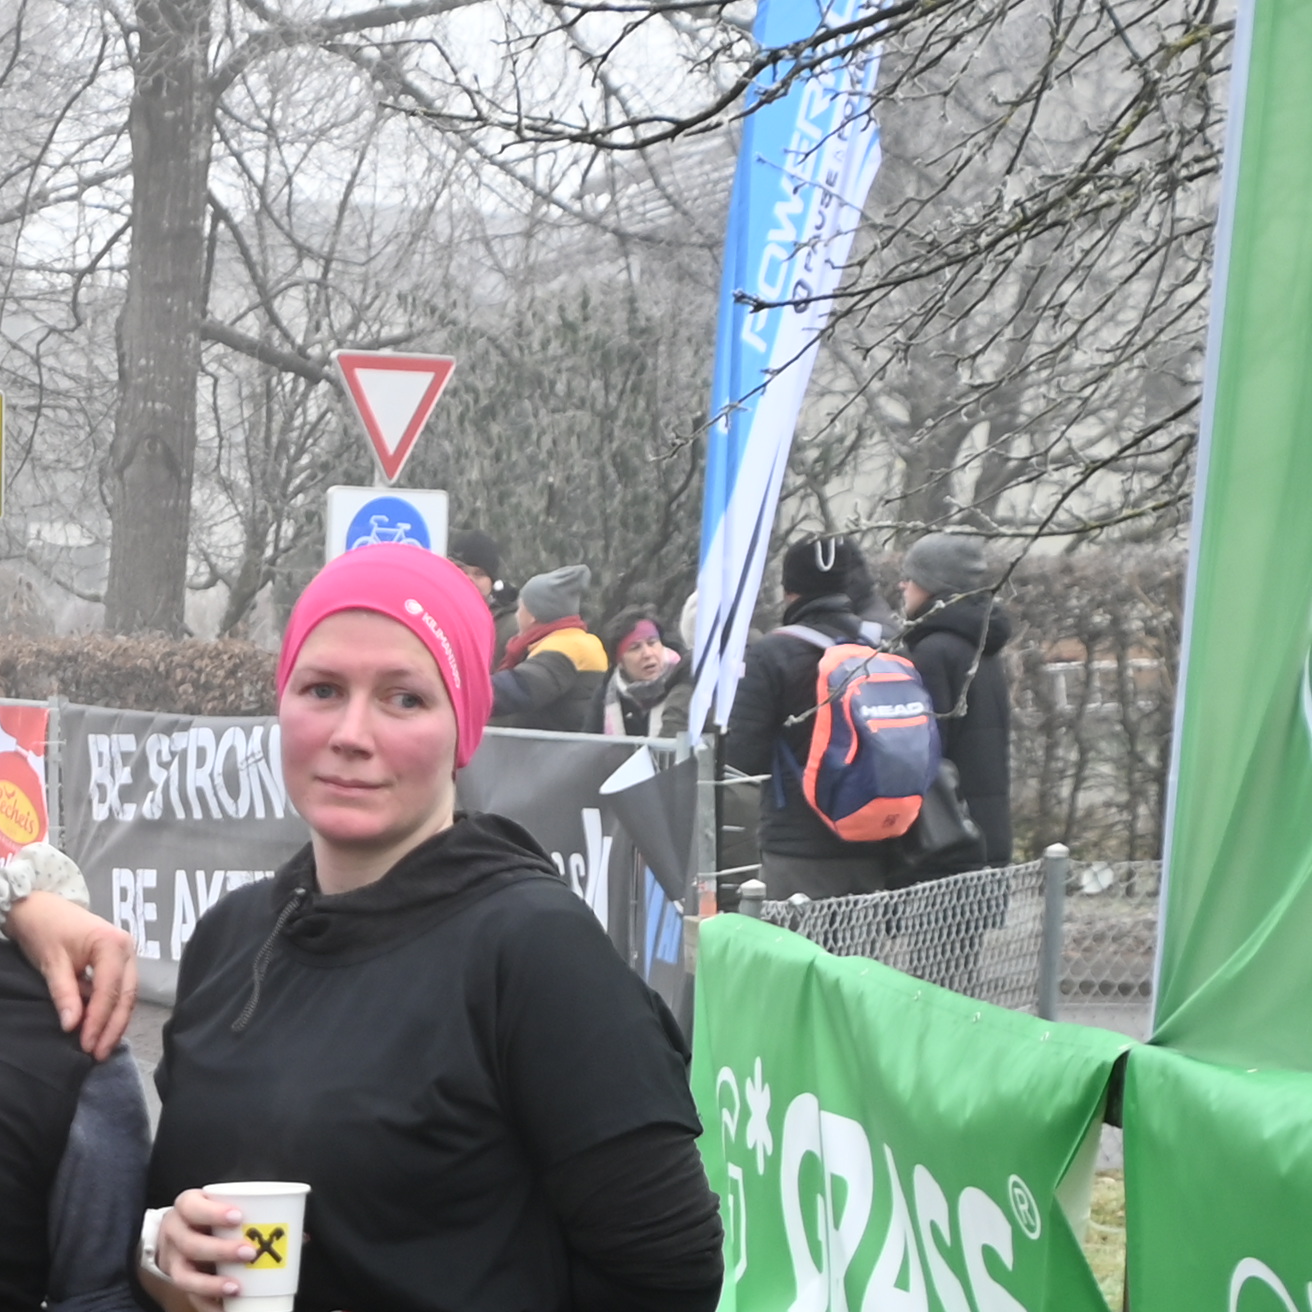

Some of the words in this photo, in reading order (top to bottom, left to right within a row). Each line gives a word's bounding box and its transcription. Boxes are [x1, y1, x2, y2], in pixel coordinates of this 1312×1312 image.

[859, 701, 925, 719] HEAD
[87, 733, 137, 821] BE
[142, 723, 301, 821] STRON
[111, 867, 160, 960] BE
